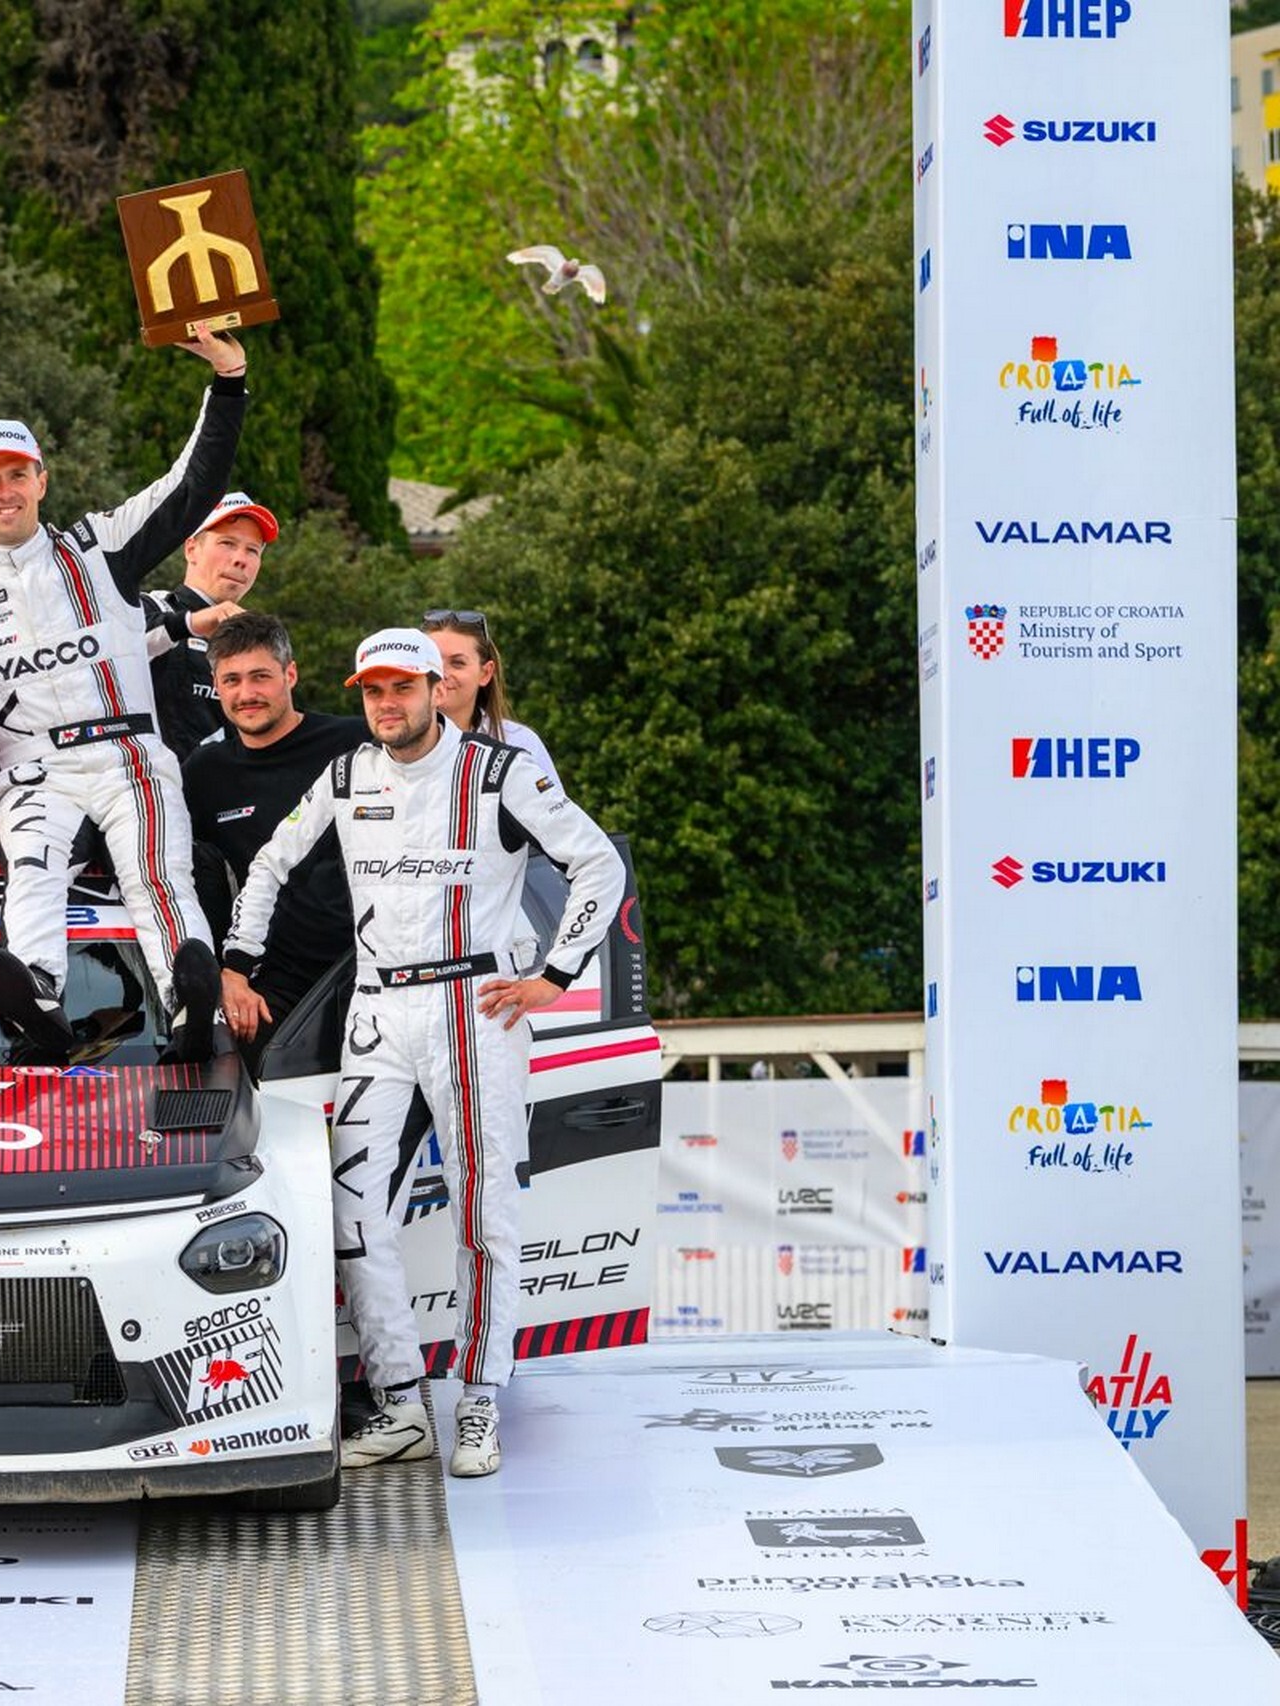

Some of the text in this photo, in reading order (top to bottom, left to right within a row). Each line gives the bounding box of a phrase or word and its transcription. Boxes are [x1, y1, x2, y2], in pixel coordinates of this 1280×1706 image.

[1049, 0, 1131, 38] HEP
[1023, 121, 1156, 142] SUZUKI
[976, 521, 1172, 543] VALAMAR
[1019, 606, 1184, 619] REPUBLIC OF CROATIA
[1019, 622, 1118, 641] Ministry of
[1019, 643, 1182, 662] Tourism and Sport
[1057, 738, 1140, 778] HEP
[1032, 862, 1165, 882] SUZUKI
[778, 1188, 833, 1204] WRC
[24, 1246, 71, 1256] INVEST
[985, 1251, 1182, 1274] VALAMAR
[184, 1298, 261, 1341] sparco
[777, 1303, 832, 1320] WRC
[697, 1572, 960, 1588] primorsko
[841, 1616, 1114, 1627] KVARNER
